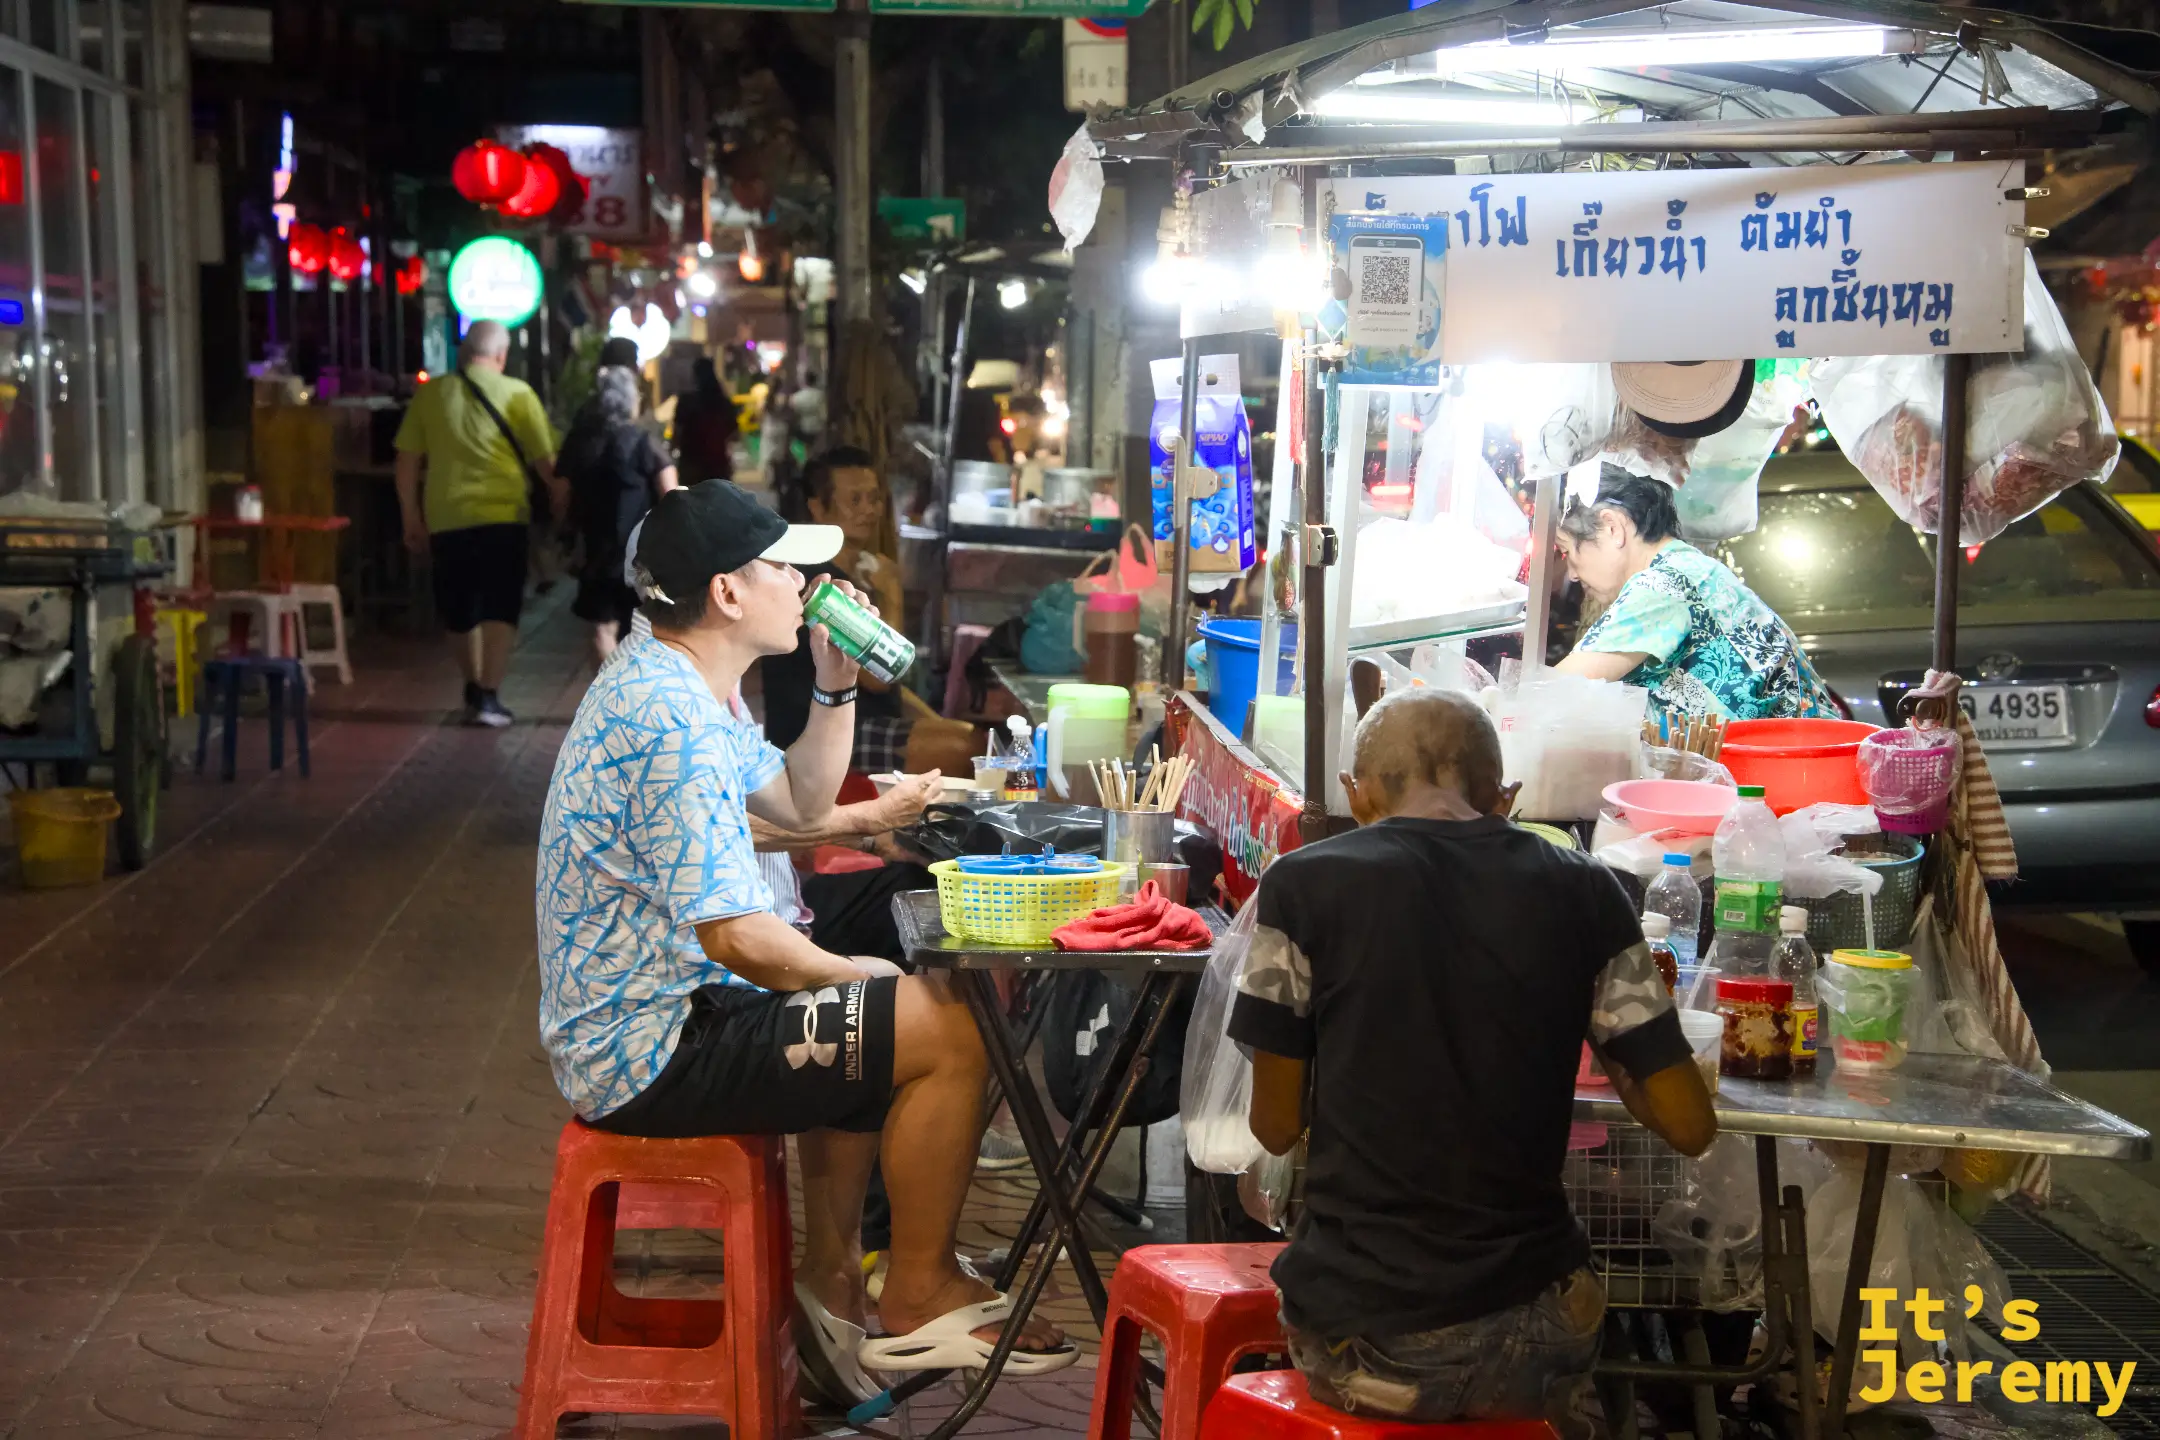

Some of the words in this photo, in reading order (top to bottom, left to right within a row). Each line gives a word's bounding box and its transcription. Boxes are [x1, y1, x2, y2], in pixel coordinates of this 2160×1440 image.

[1555, 199, 1707, 283] เกี๊ยวน้ำ
[1740, 191, 1853, 252] ต้มยำ
[1774, 248, 1955, 349] ลูกชิ้นหมู
[1988, 692, 2060, 720] 4935
[845, 1031, 856, 1080] UNDER
